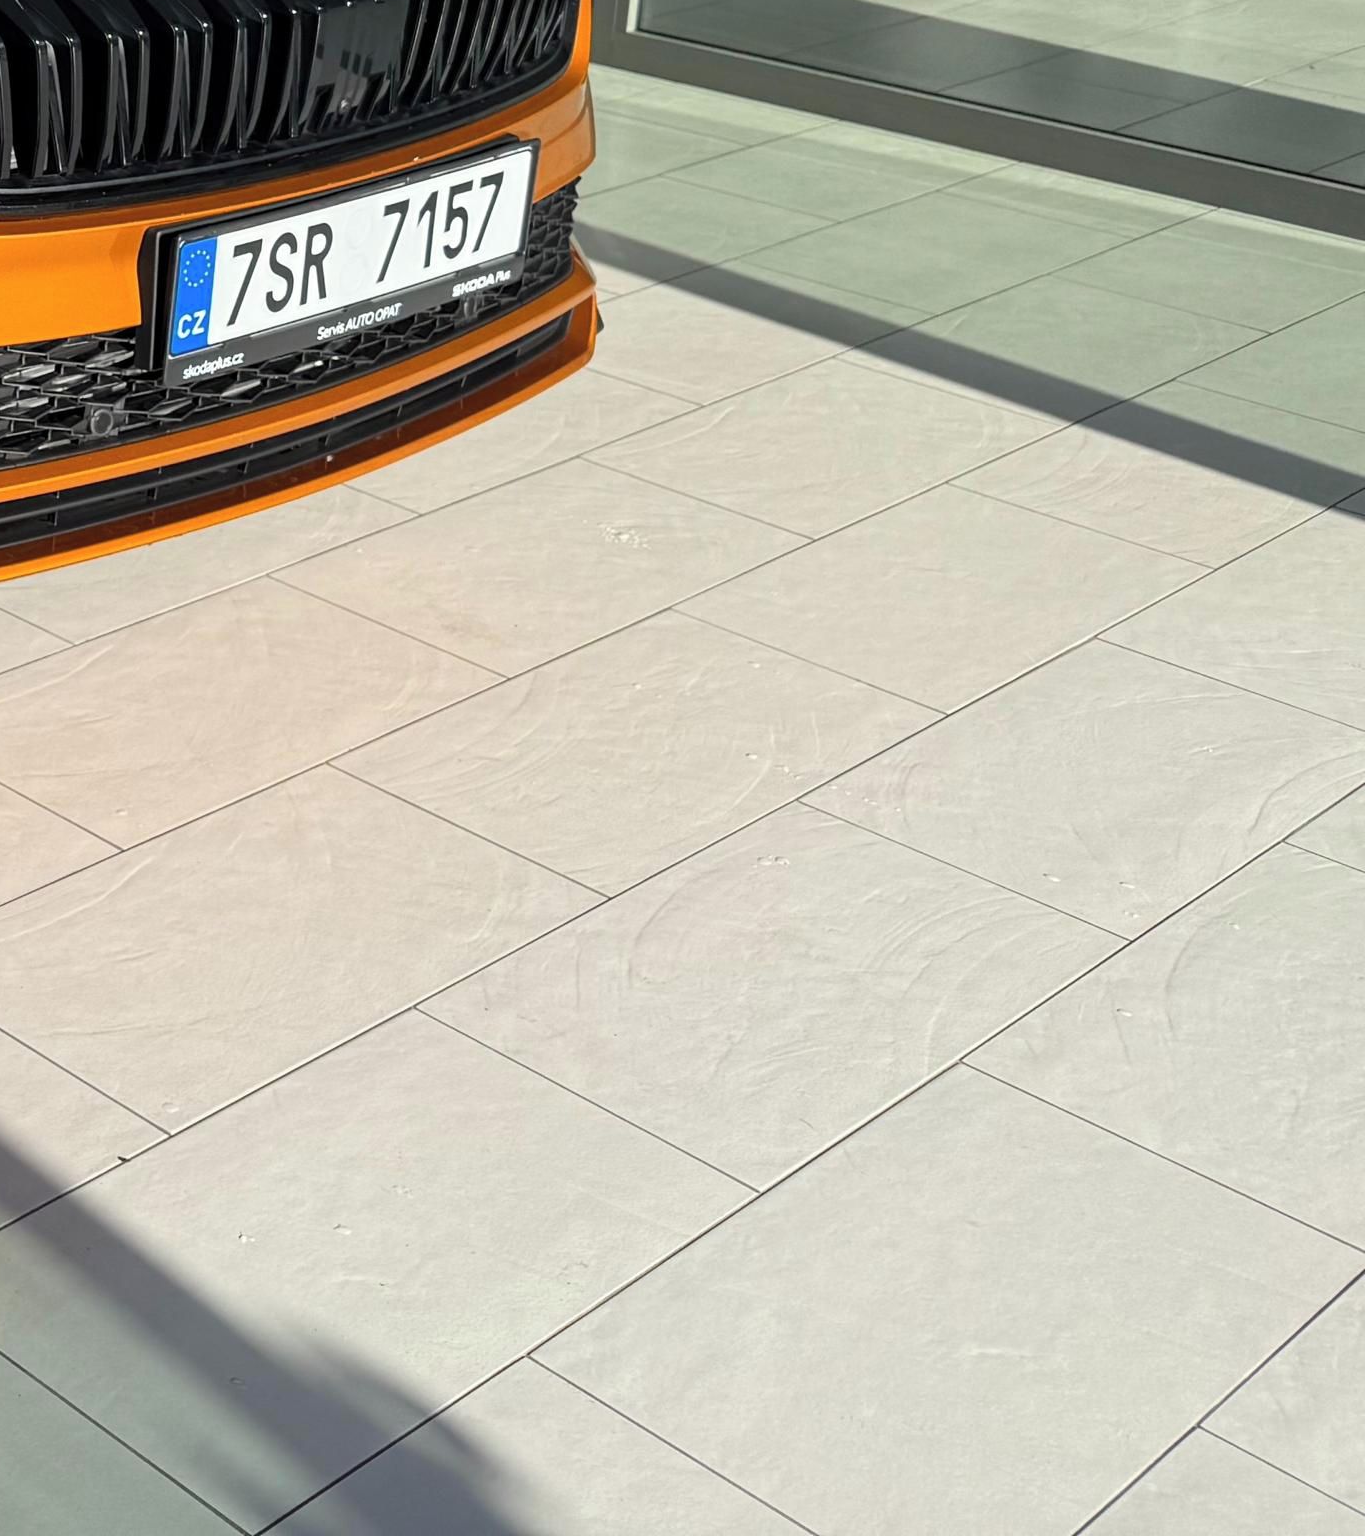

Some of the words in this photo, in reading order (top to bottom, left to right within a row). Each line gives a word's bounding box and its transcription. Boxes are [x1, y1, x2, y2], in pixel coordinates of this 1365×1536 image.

[176, 308, 207, 340] CZ
[226, 222, 333, 327] 7SR
[375, 171, 505, 284] 7157
[182, 352, 245, 380] skodaplus.cz
[316, 321, 346, 340] Servis
[345, 311, 375, 332] AUTO
[375, 302, 403, 322] OPAT
[495, 270, 511, 283] Plus
